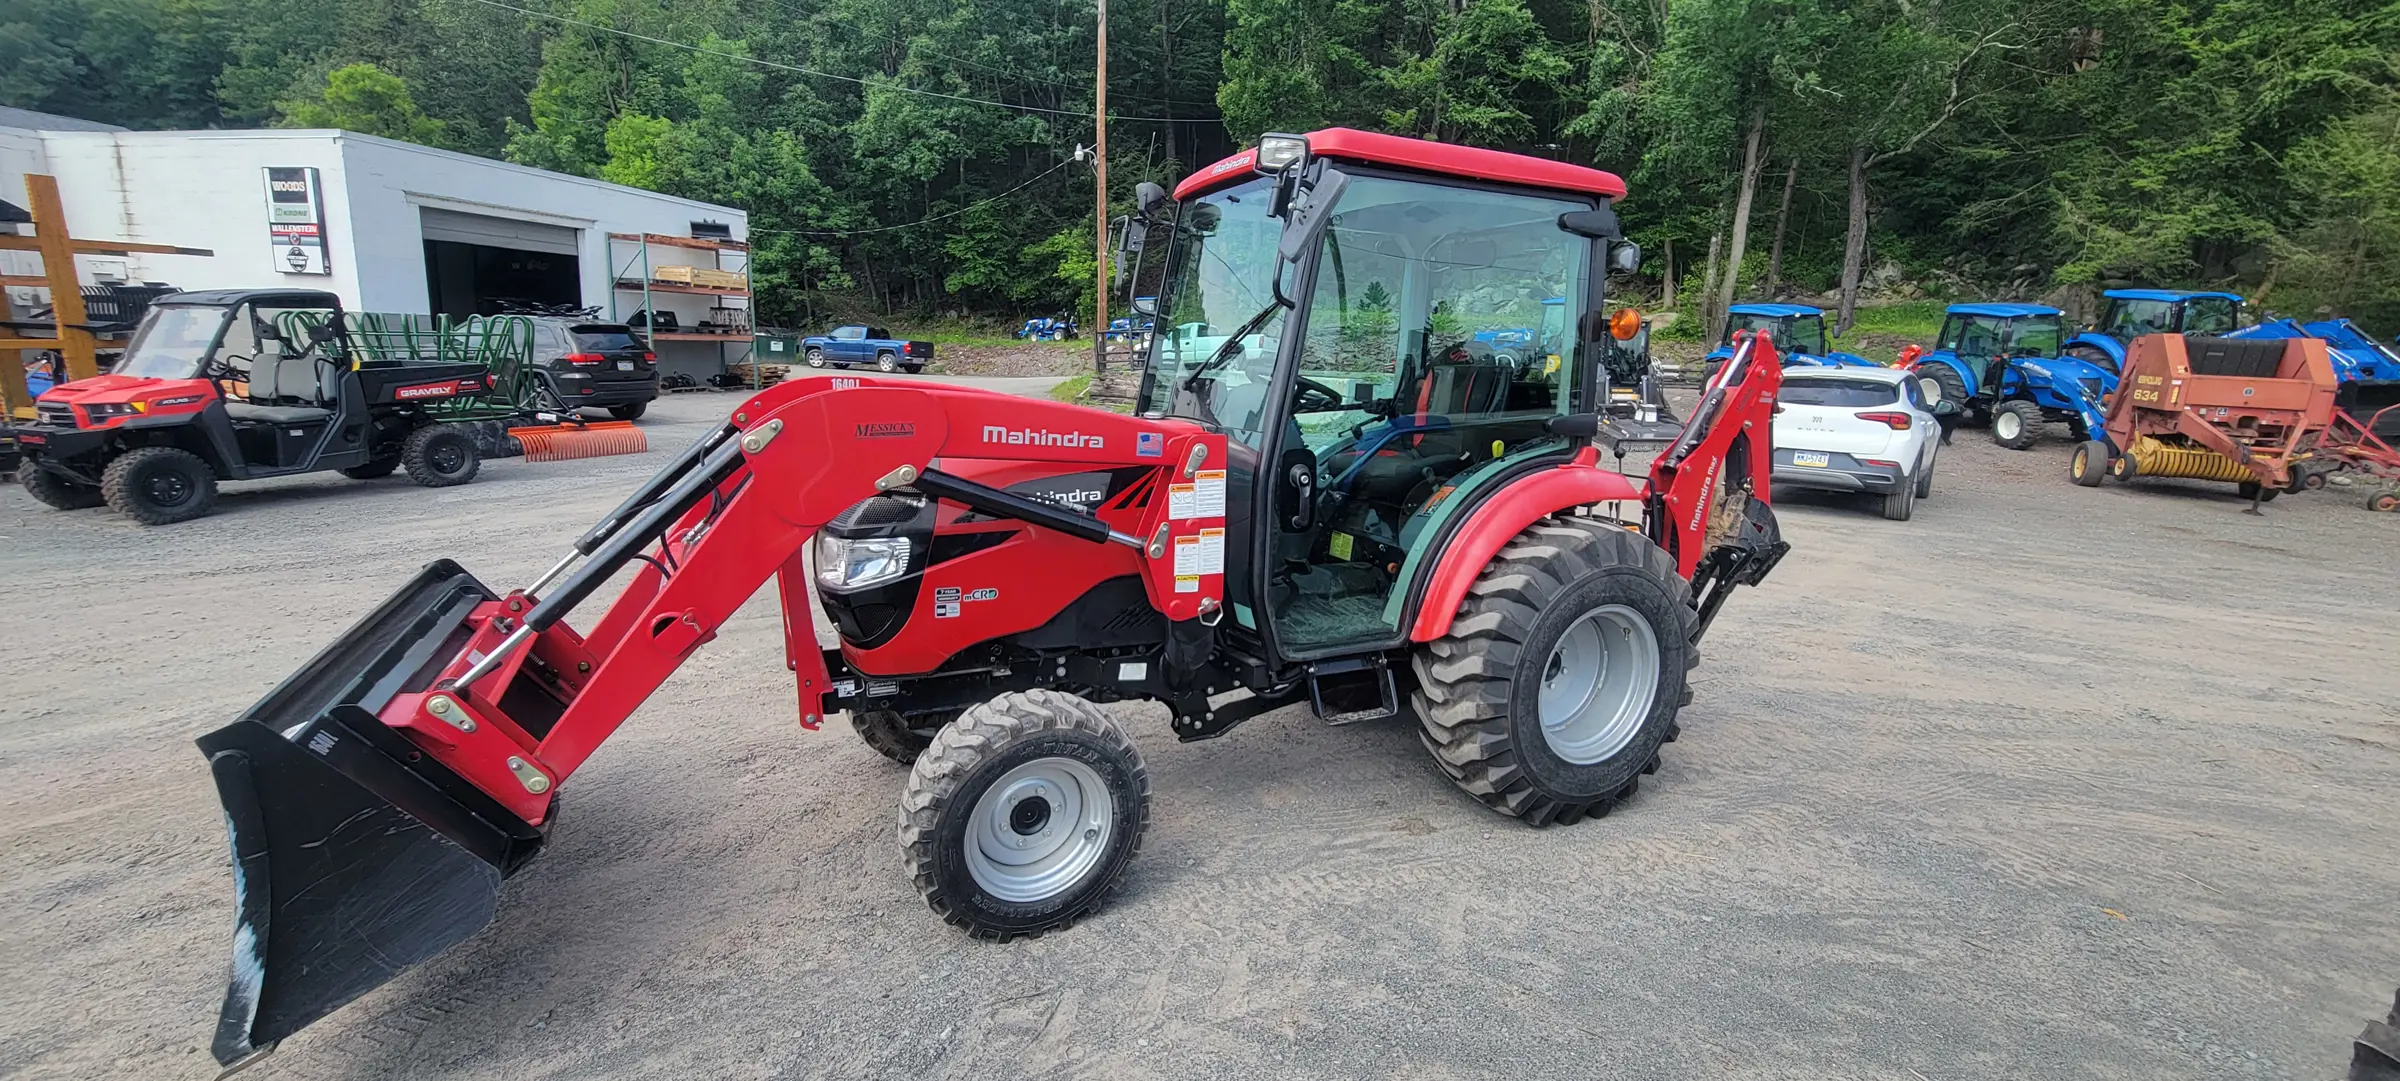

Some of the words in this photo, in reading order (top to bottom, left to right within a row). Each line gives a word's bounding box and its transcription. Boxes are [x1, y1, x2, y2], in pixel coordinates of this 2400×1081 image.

[1212, 156, 1250, 175] Mahindra
[271, 181, 306, 192] WOODS
[272, 224, 318, 233] WALLENSTEIN
[400, 386, 451, 397] GRAVELY
[2133, 389, 2159, 402] 634
[162, 397, 189, 405] ATLAS
[983, 425, 1104, 449] Mahindra
[1689, 476, 1712, 532] Mahindra
[1707, 455, 1718, 475] max
[308, 729, 339, 756] 1640L
[1043, 742, 1101, 762] TITAN
